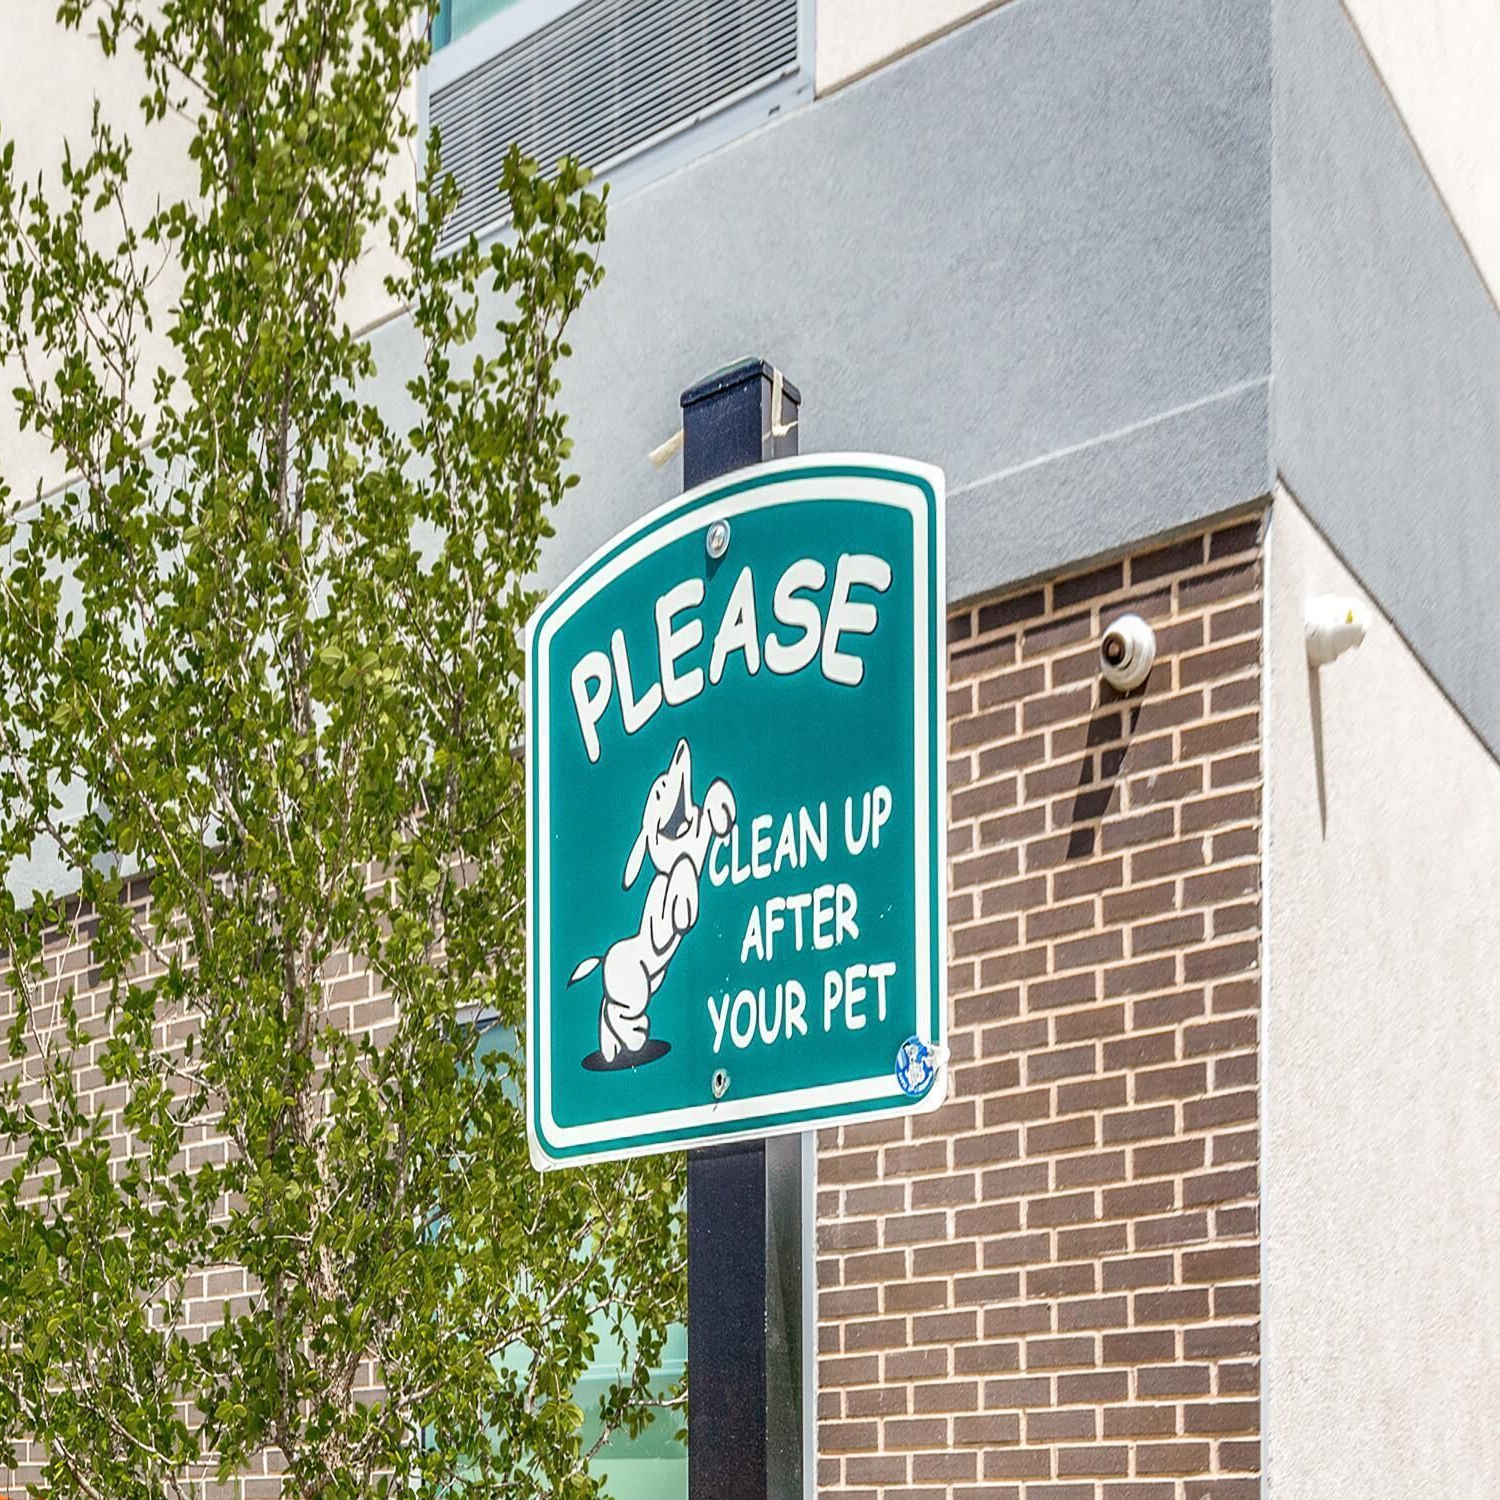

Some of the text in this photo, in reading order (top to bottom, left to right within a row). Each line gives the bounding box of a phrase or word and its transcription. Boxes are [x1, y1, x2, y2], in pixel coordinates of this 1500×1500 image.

[570, 552, 892, 764] PLEASE
[709, 784, 892, 887] CLEAN UP
[740, 883, 860, 964] AFTER
[707, 961, 897, 1054] YOUR PET
